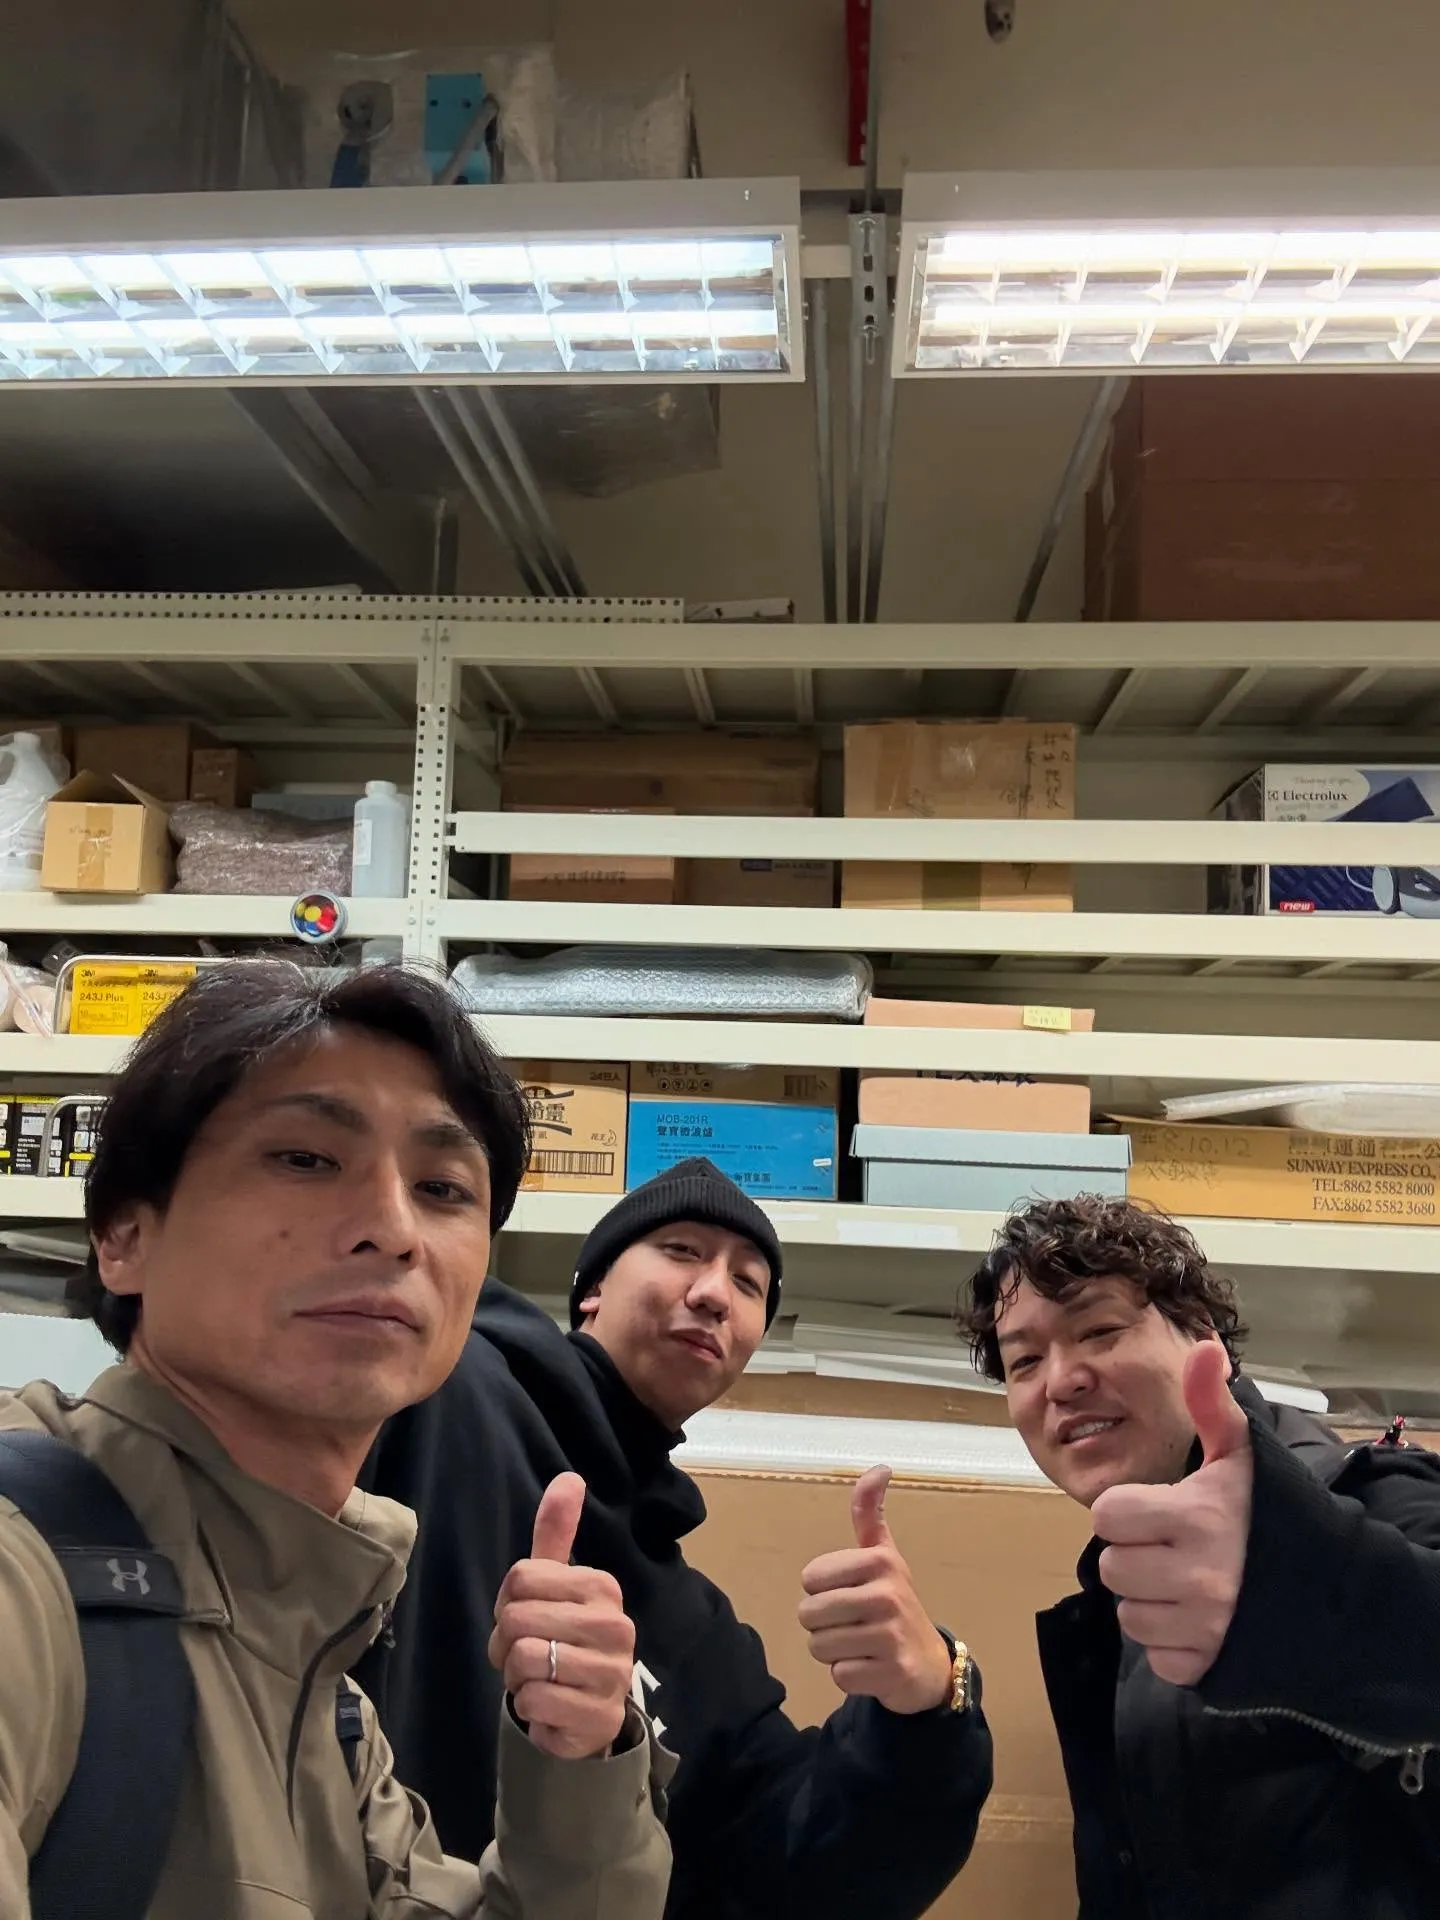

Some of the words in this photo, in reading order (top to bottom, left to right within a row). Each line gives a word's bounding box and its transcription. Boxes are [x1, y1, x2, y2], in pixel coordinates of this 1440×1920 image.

[1283, 789, 1349, 801] Electrolux
[1284, 901, 1312, 911] new
[81, 969, 96, 978] 3M
[144, 968, 158, 977] 3M
[80, 992, 103, 1001] 243J
[105, 992, 124, 1002] Plus
[1287, 1158, 1345, 1174] SUNWAY
[1349, 1161, 1408, 1177] EXPRESS
[1410, 1164, 1437, 1180] CO.,
[1312, 1178, 1372, 1194] TEL:8862
[1375, 1181, 1403, 1195] 5582
[1405, 1183, 1435, 1197] 8000
[1312, 1196, 1373, 1213] FAX:8862
[1375, 1200, 1403, 1214] 5582
[1406, 1202, 1435, 1216] 3680
